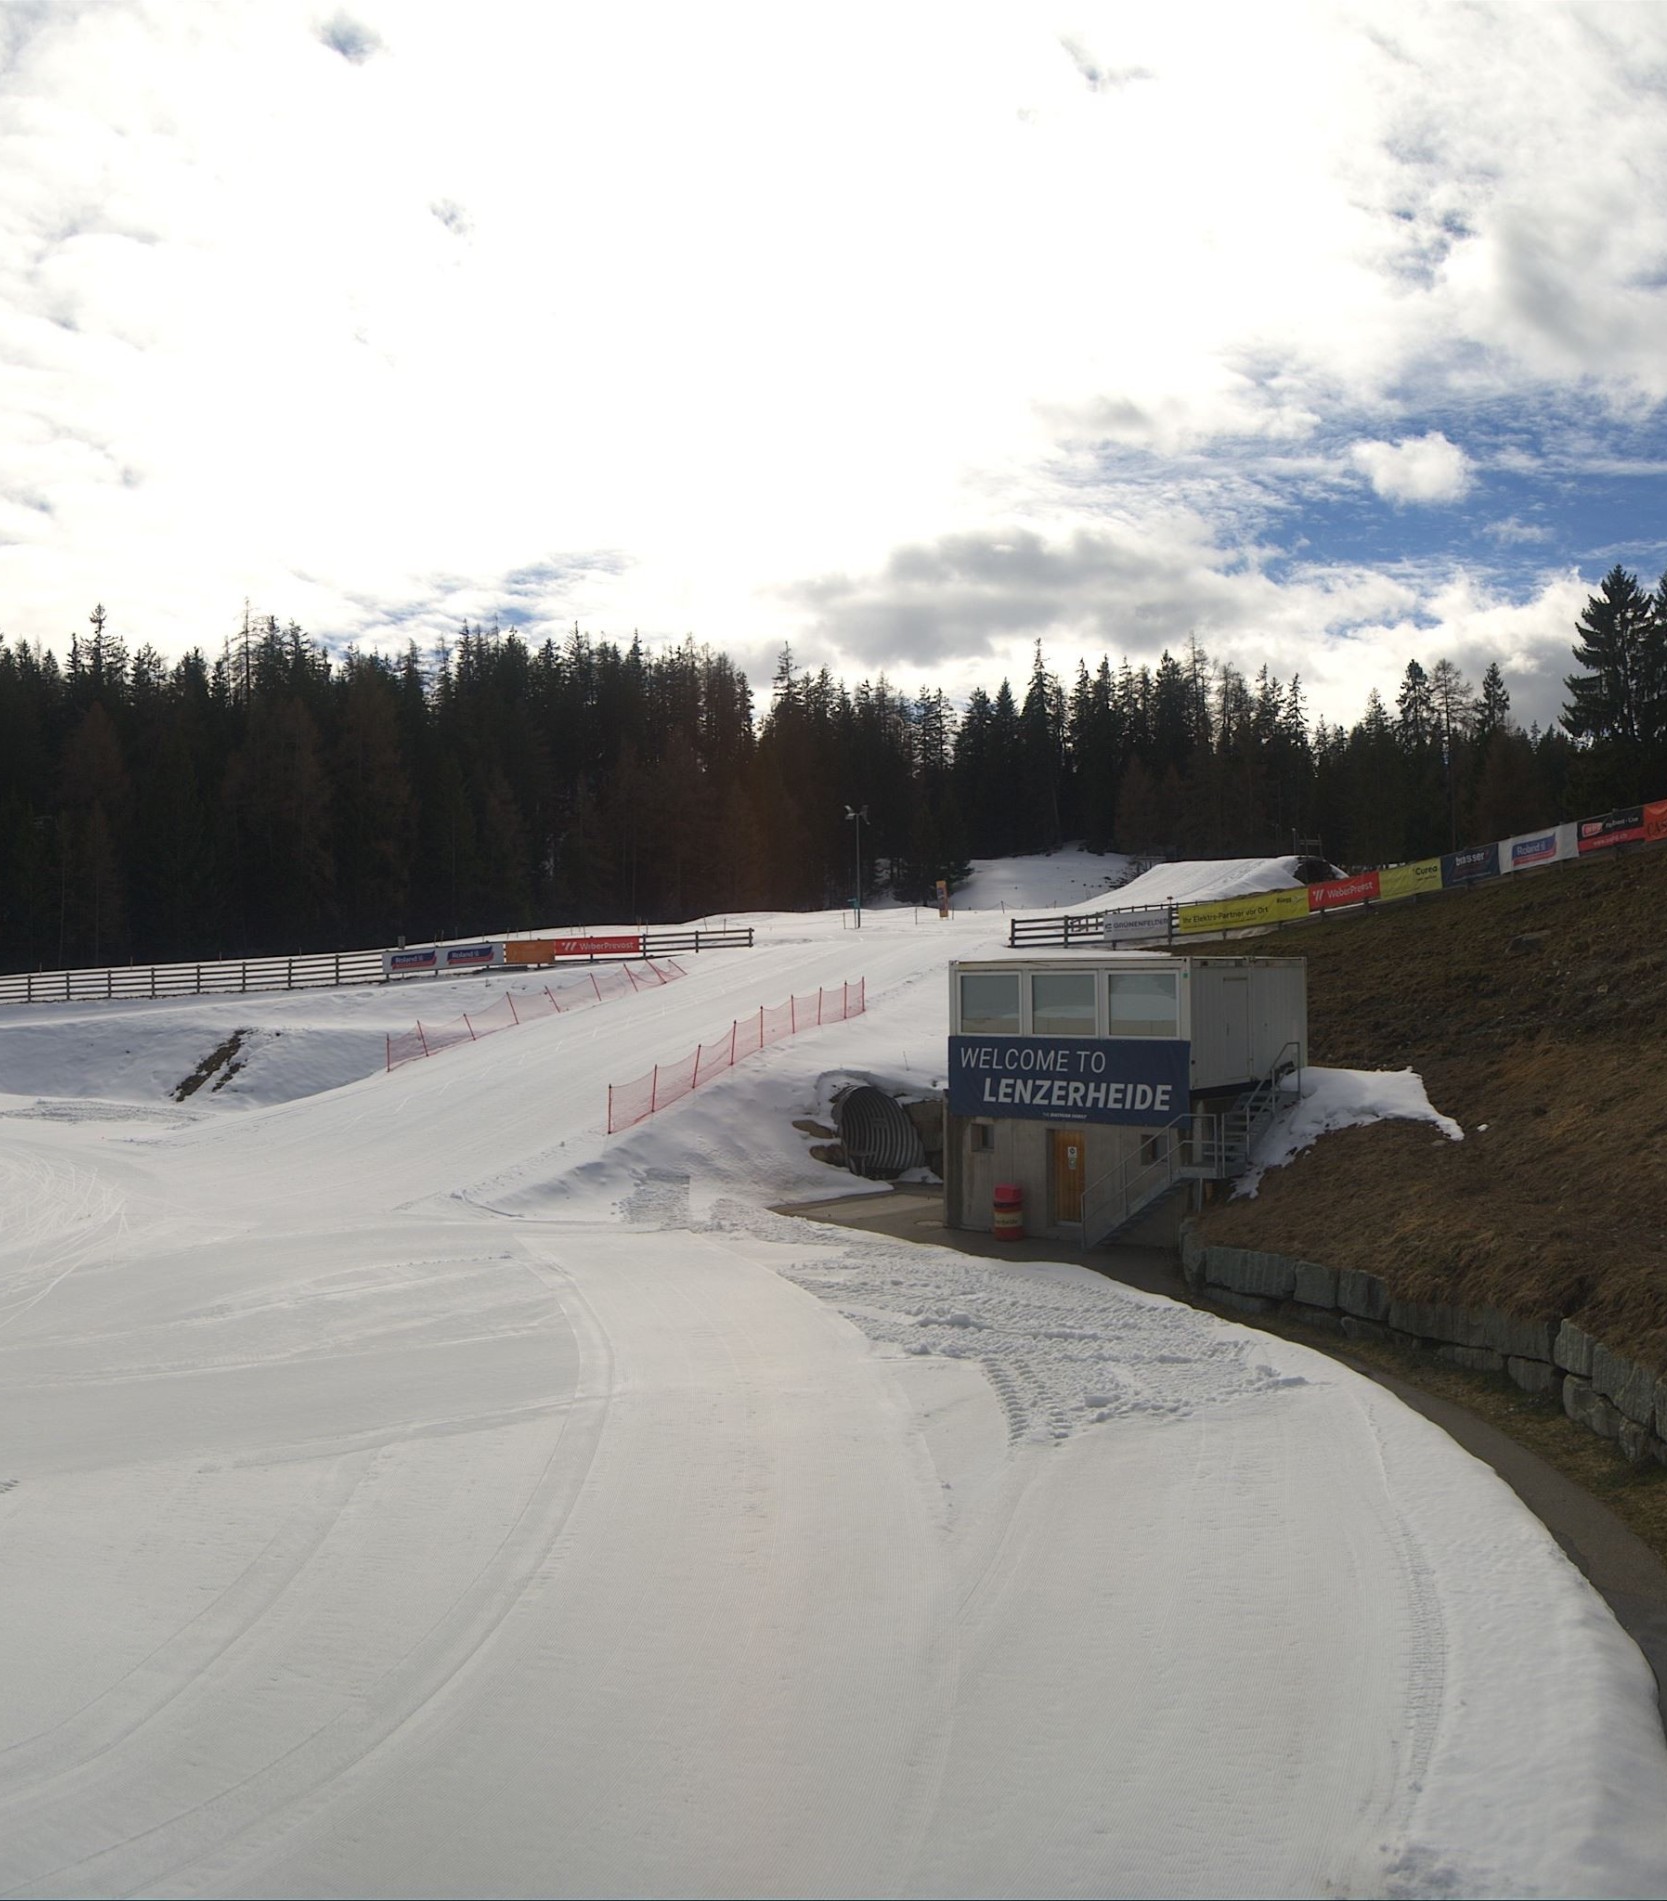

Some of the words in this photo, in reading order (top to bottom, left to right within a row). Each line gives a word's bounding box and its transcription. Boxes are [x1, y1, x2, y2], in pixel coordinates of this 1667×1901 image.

[1192, 911, 1244, 924] Elektro-Partner
[1257, 906, 1269, 914] Ort
[961, 1047, 1070, 1072] WELCOME
[1076, 1051, 1106, 1073] TO
[983, 1077, 1172, 1111] LENZERHEIDE
